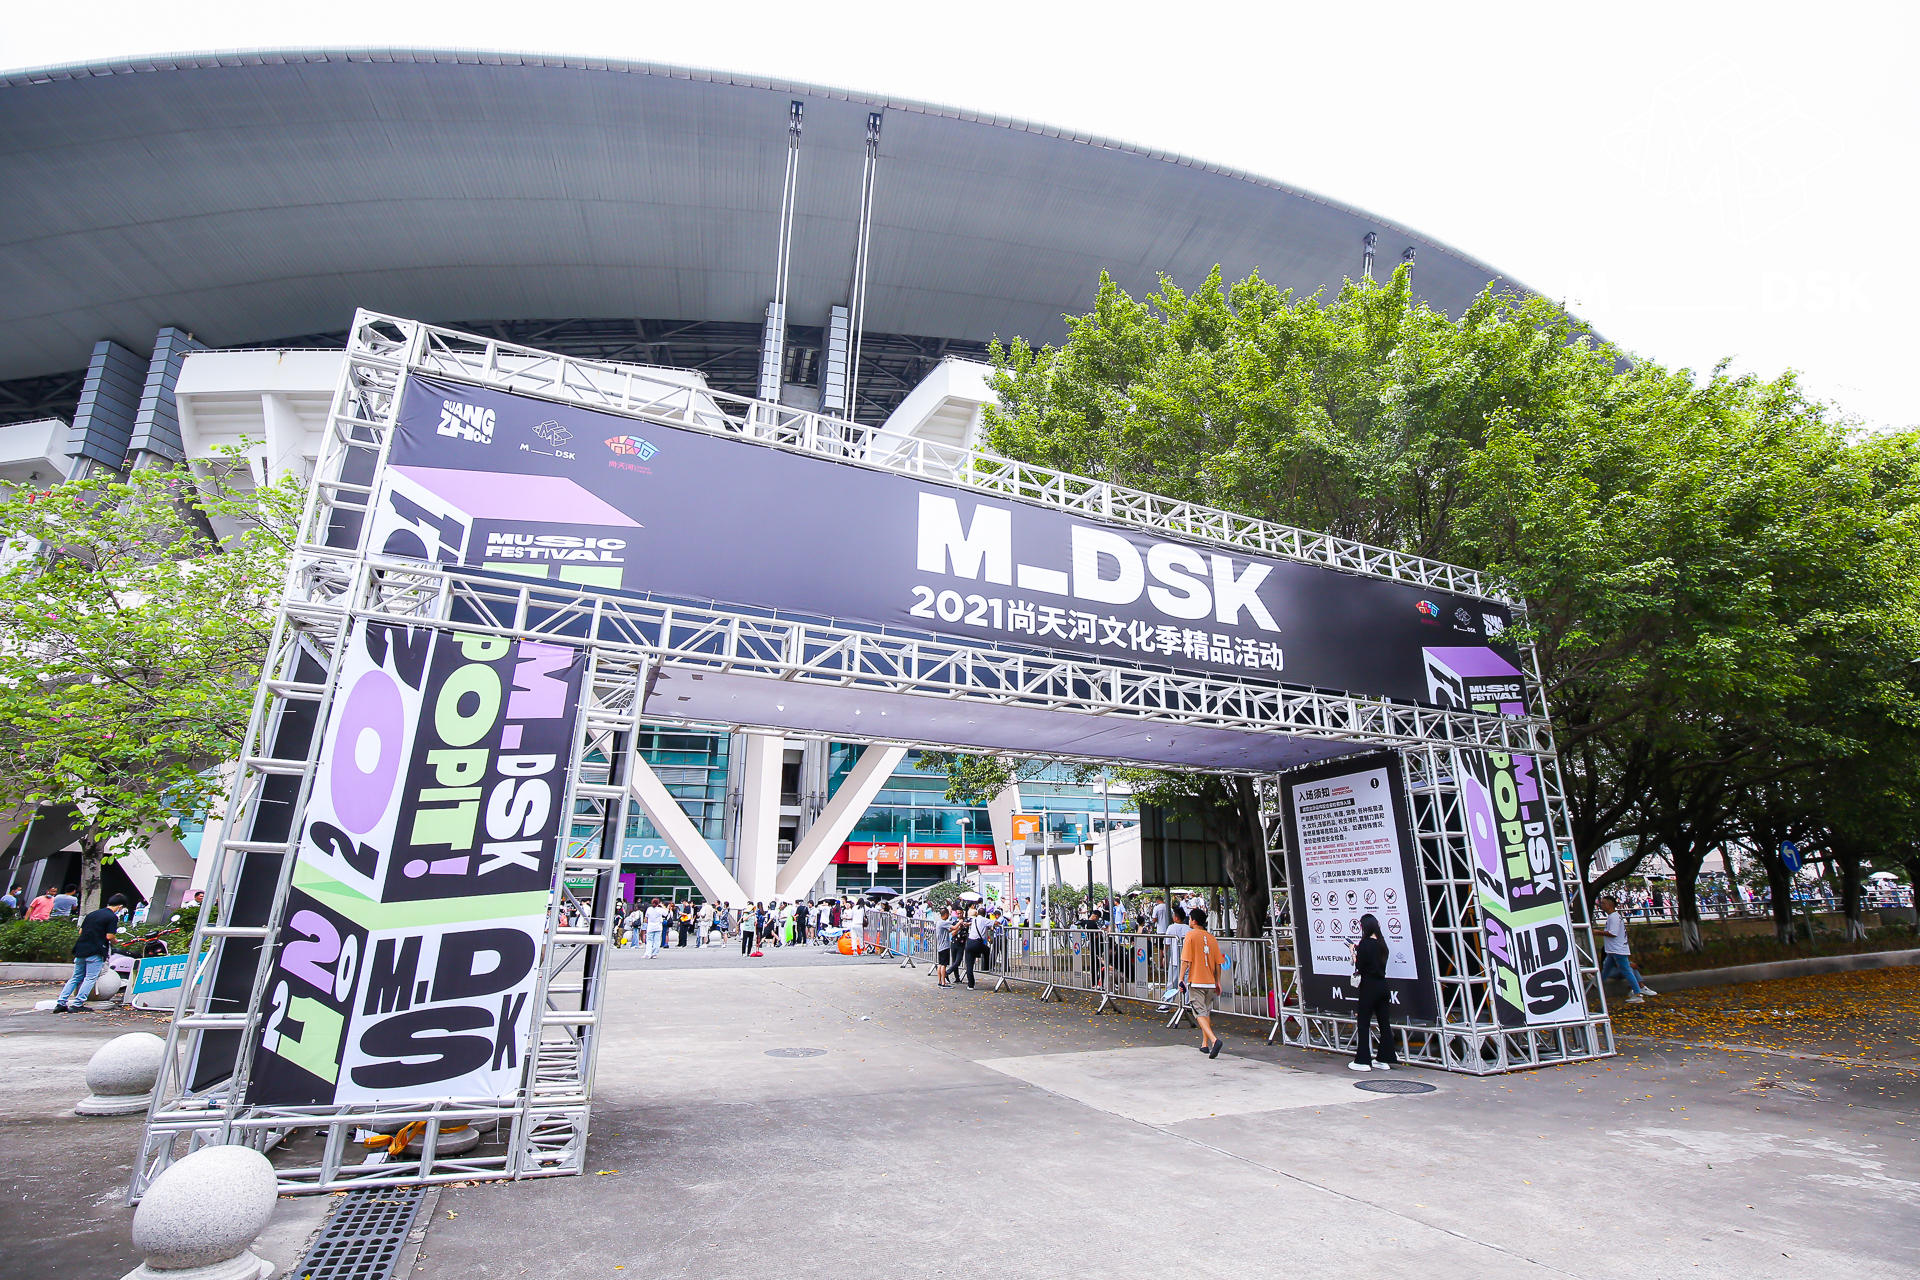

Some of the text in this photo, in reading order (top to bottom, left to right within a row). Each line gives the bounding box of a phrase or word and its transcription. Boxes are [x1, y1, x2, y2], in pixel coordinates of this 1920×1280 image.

[487, 532, 627, 550] MUSIC
[484, 545, 625, 563] FESTIVAL
[909, 584, 1284, 673] 2021尚天河文化季精品活动
[1469, 683, 1521, 693] MUSIC
[1470, 691, 1522, 702] FESTIVAL
[1298, 787, 1331, 802] 入场须知
